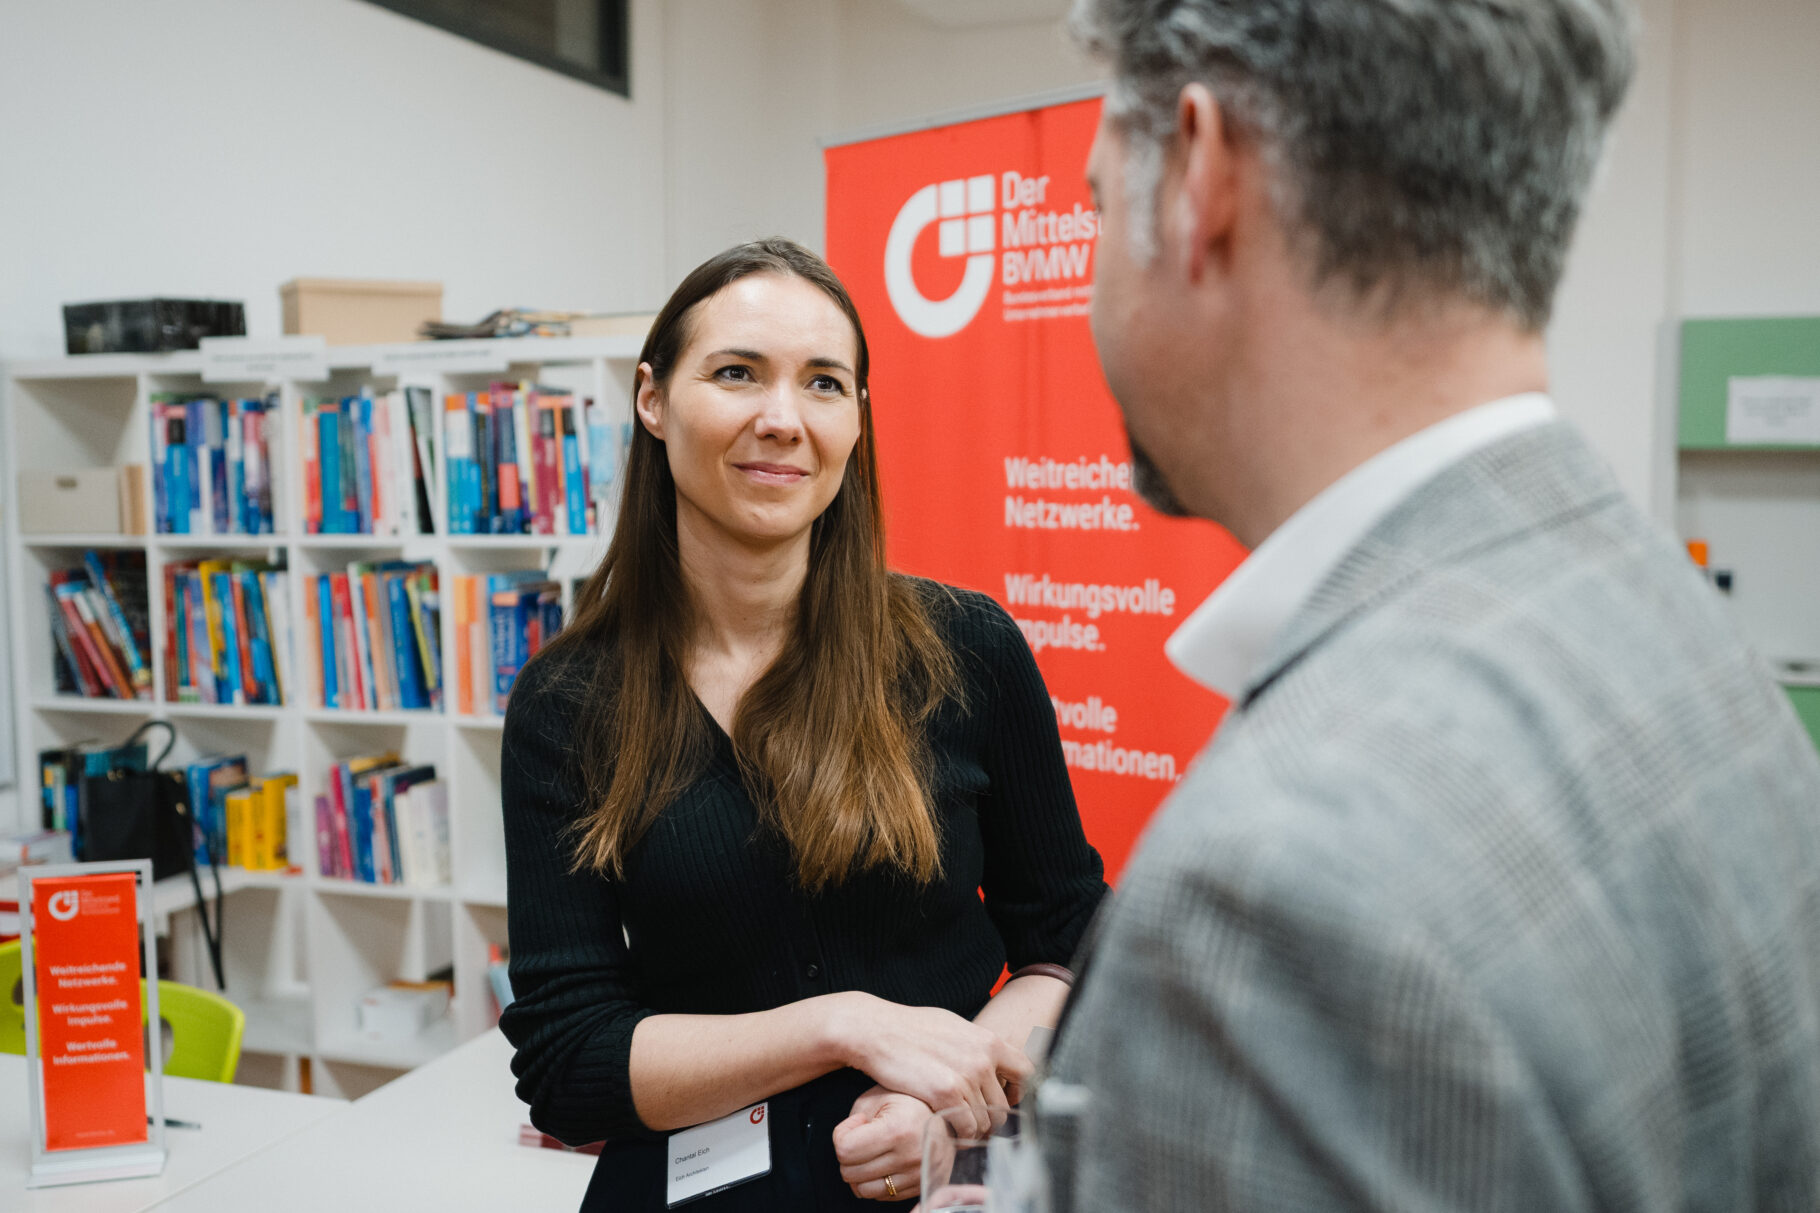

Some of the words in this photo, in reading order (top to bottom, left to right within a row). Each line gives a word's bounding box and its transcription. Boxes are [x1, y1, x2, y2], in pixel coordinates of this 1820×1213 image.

[1002, 170, 1050, 209] Der
[1003, 203, 1103, 248] Mittels
[1002, 243, 1090, 285] BVMW
[1004, 454, 1134, 490] Weitreiche
[1005, 495, 1140, 531] Netzwerke.
[1004, 573, 1175, 619] Wirkungsvolle
[1009, 612, 1106, 652] mpulse.
[1051, 696, 1117, 733] volle
[1062, 739, 1182, 782] mationen.
[50, 961, 126, 976] Weitreichende
[58, 975, 118, 988] Netzwerke.
[52, 999, 128, 1015] Wirkungsvolle
[67, 1014, 113, 1027] Impulse.
[53, 1051, 130, 1066] Informationen.
[66, 1038, 117, 1052] Wertvolle
[675, 1152, 697, 1164] Chantal
[698, 1147, 710, 1156] Eich
